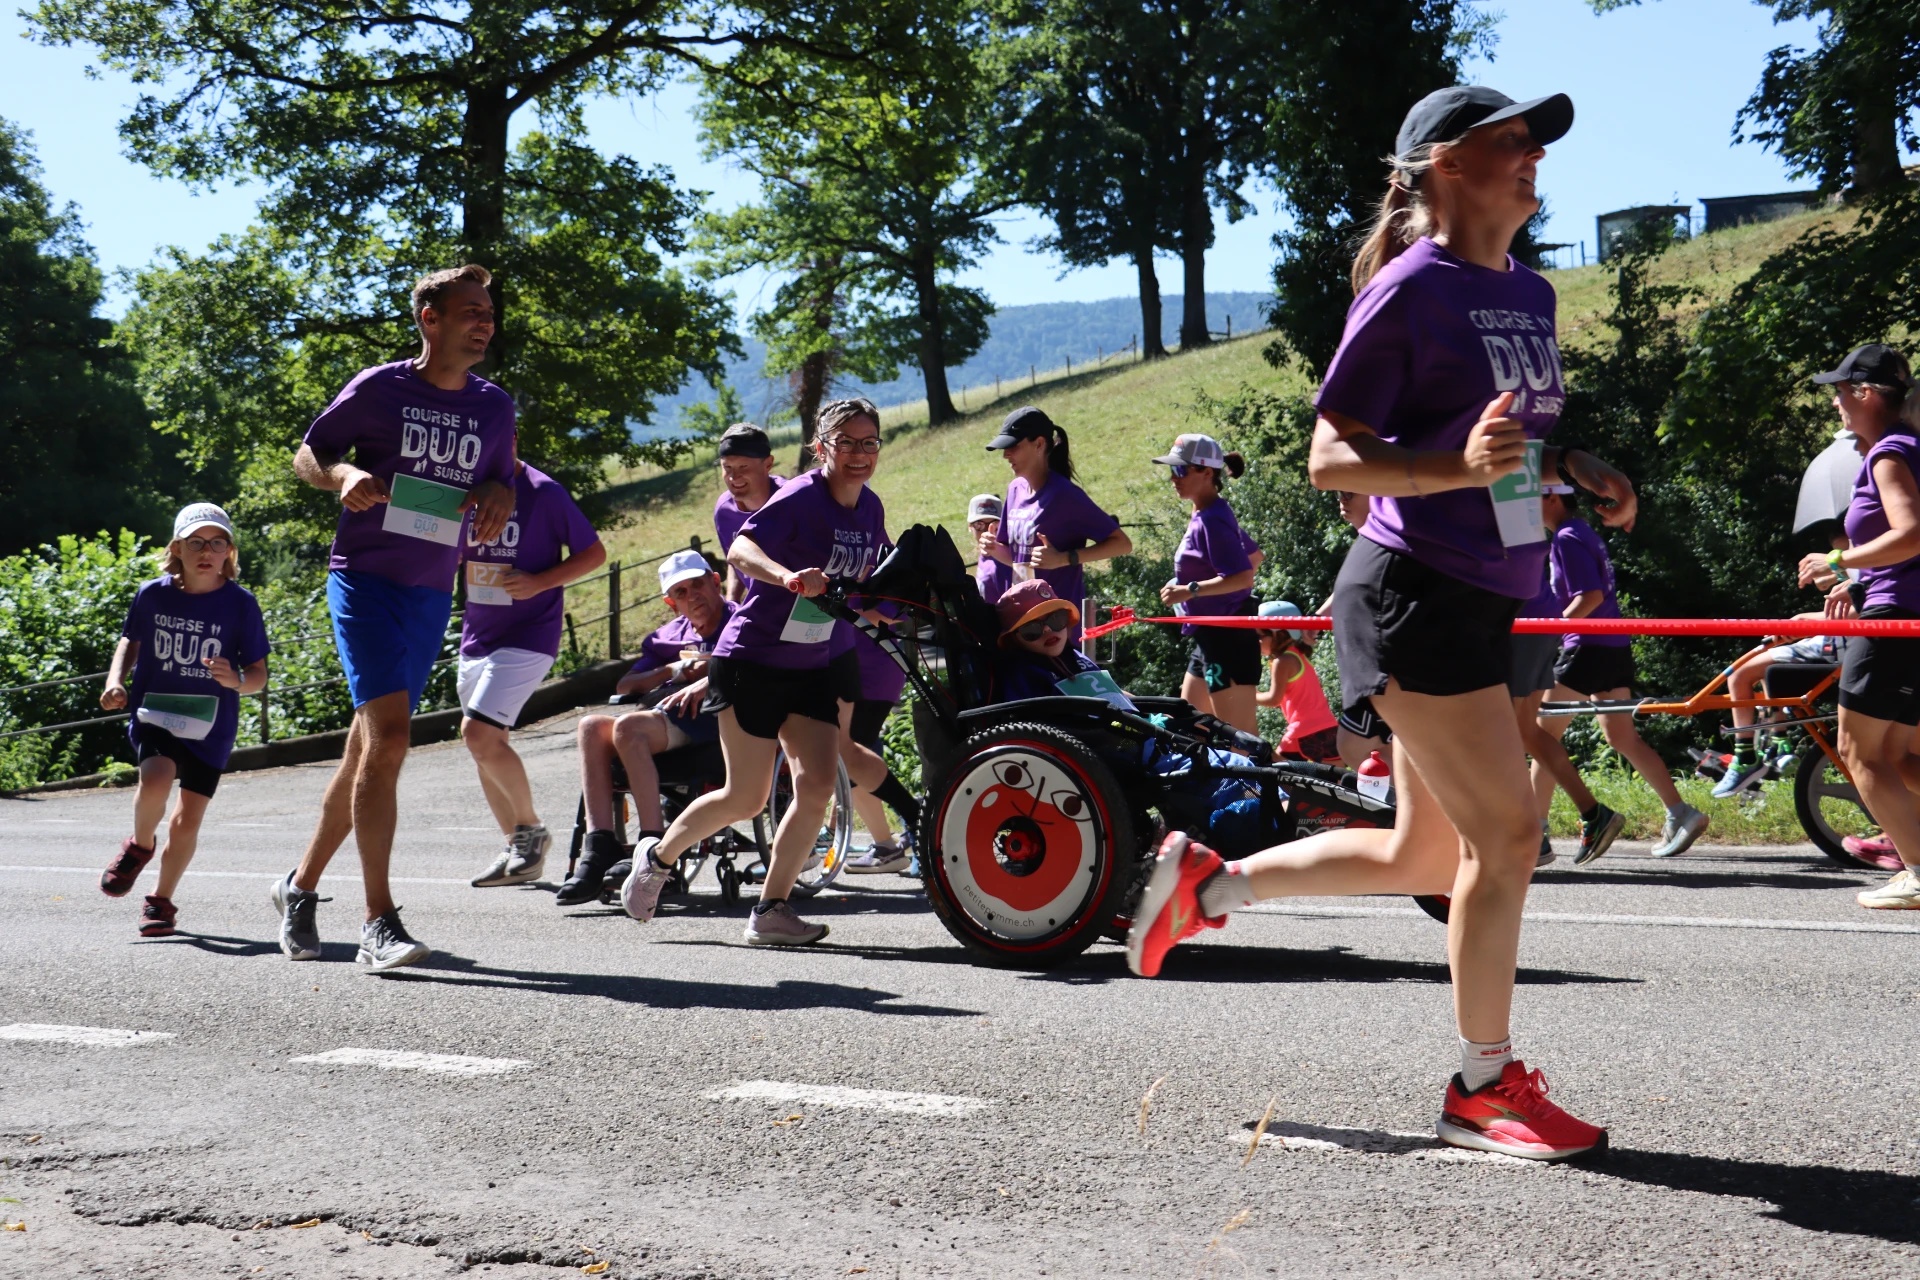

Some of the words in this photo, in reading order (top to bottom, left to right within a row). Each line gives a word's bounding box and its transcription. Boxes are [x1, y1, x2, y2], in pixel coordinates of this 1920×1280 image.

[1468, 309, 1537, 331] COURSE
[402, 406, 461, 428] COURSE
[400, 422, 482, 470] DUO
[433, 465, 474, 484] SUISSE
[414, 485, 444, 513] 2
[413, 518, 439, 533] DUO
[466, 520, 520, 553] DO
[489, 547, 518, 558] SUISSE
[472, 564, 500, 585] 127
[154, 613, 205, 634] COURSE
[154, 628, 222, 667] DUO
[180, 665, 217, 680] SUISS
[1082, 674, 1108, 693] 2
[162, 716, 187, 731] DUO
[1277, 774, 1346, 791] RATHON
[1297, 817, 1347, 826] HIPPOCAMPE
[963, 884, 1035, 927] petitepomme.ch
